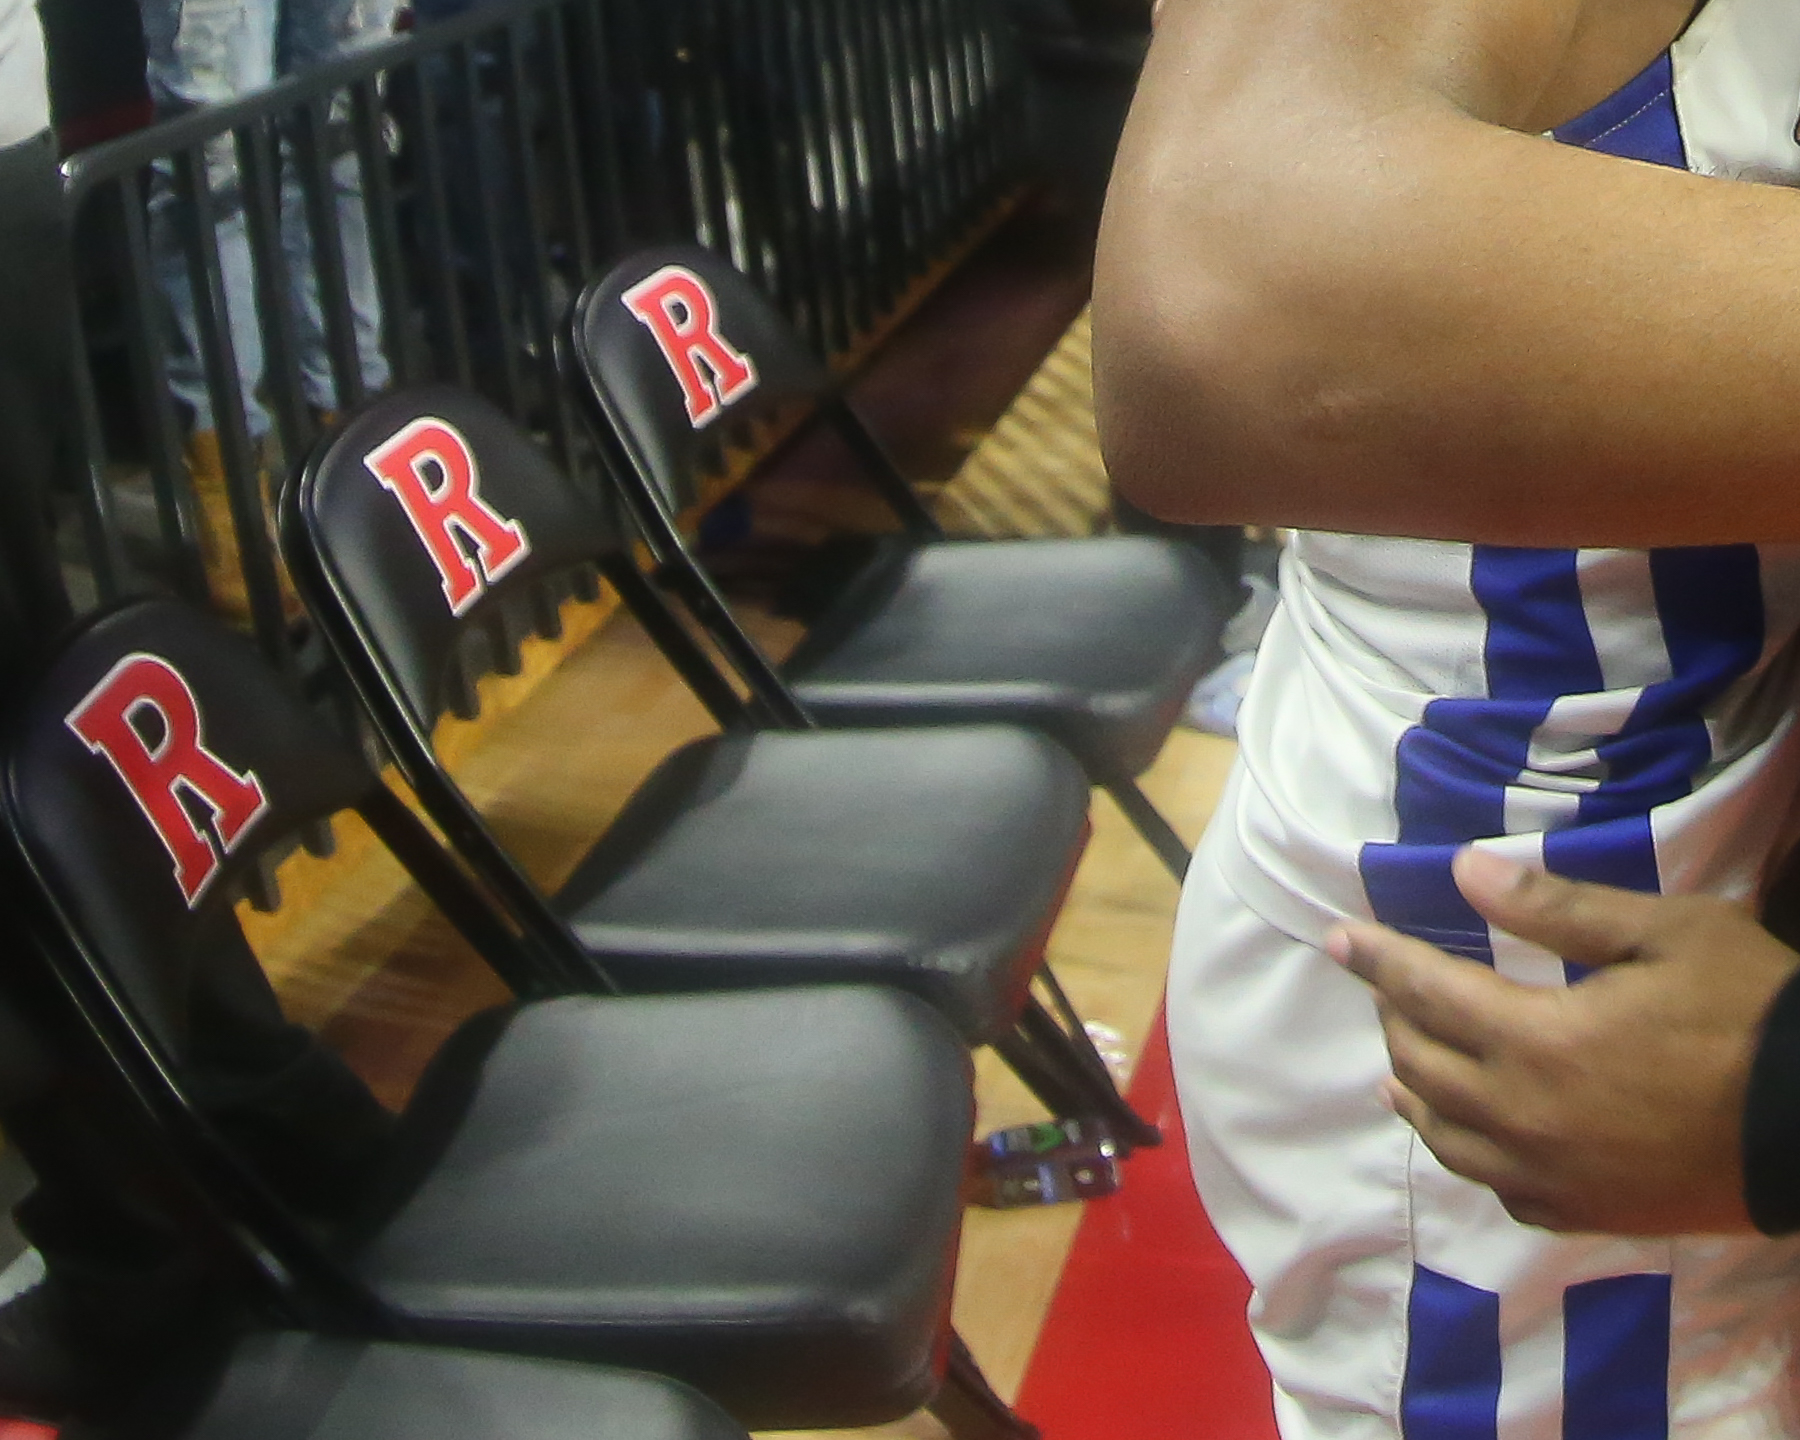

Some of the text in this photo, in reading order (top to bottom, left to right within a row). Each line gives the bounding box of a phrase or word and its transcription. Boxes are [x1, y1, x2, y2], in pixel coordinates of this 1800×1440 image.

[622, 264, 758, 429] R
[363, 416, 532, 618] R
[65, 651, 268, 909] R
